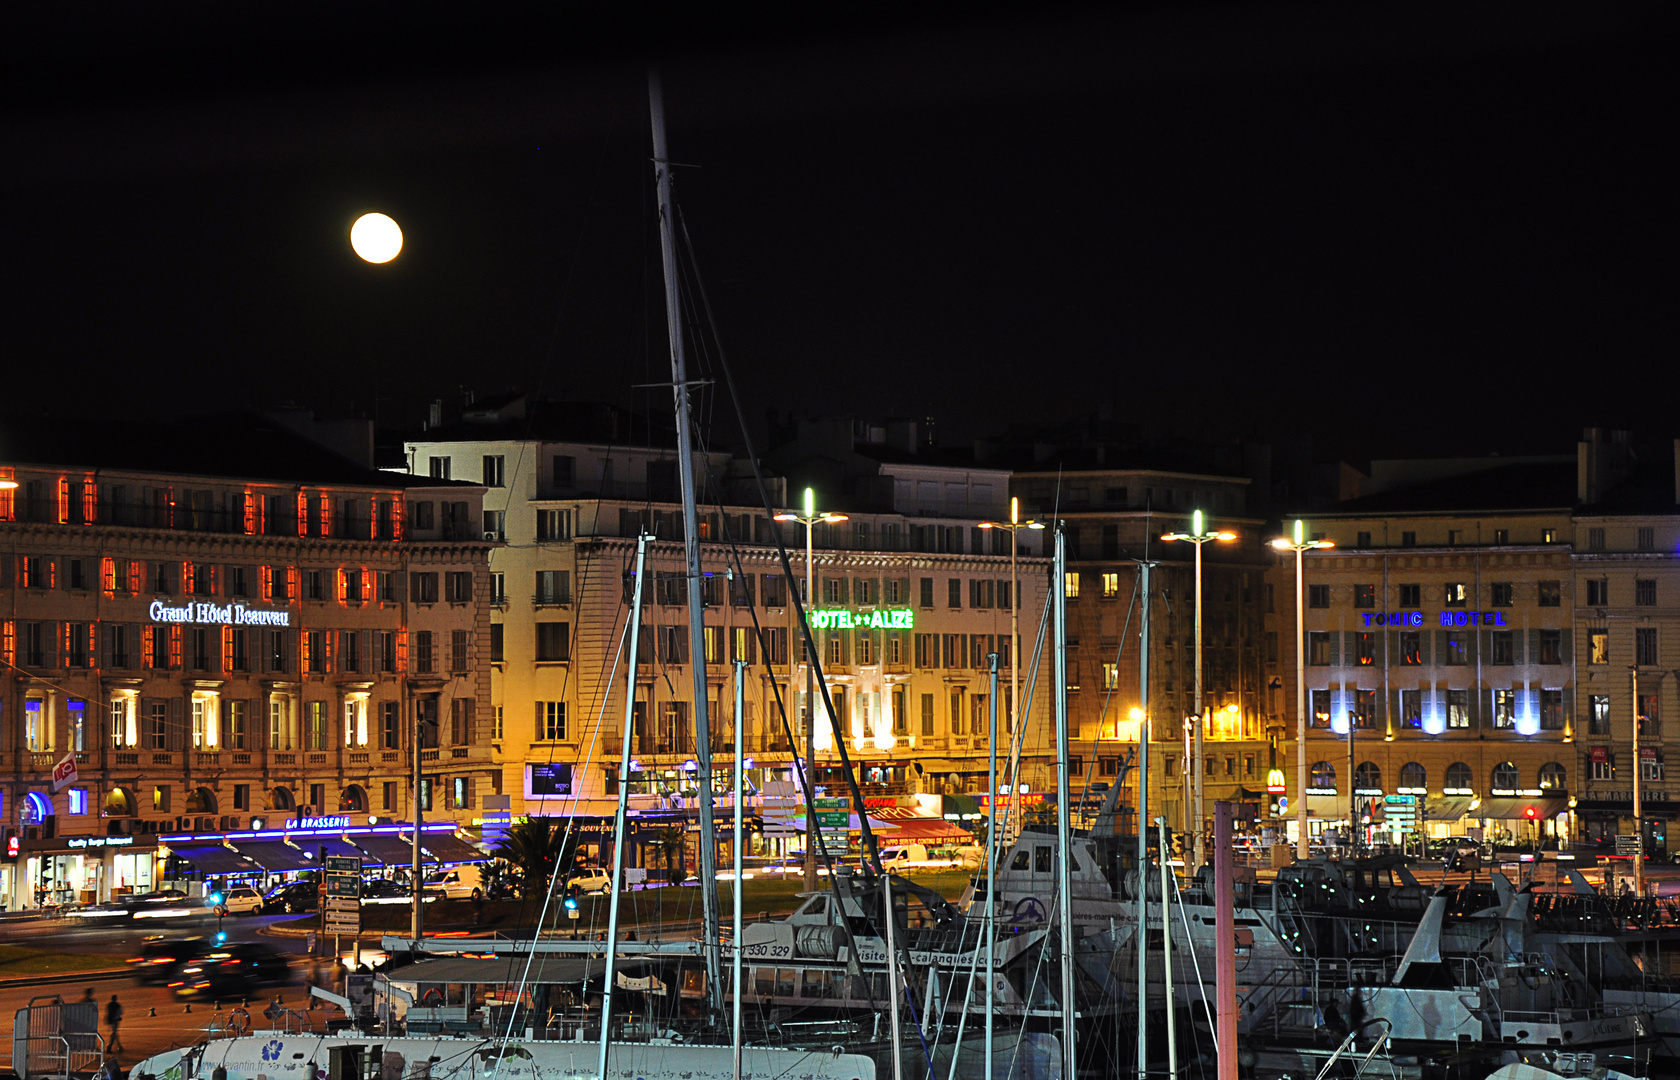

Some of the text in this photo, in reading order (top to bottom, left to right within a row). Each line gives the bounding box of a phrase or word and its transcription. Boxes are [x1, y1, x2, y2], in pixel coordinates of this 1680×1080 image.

[149, 601, 290, 626] Grand Hôtel Beauvau
[805, 609, 855, 629] HOTEL
[1361, 610, 1506, 627] TONIC HOTEL
[1603, 790, 1665, 801] MARIIERE
[285, 816, 350, 829] LA BRASSERIE
[748, 945, 768, 956] 330
[770, 946, 790, 957] 329
